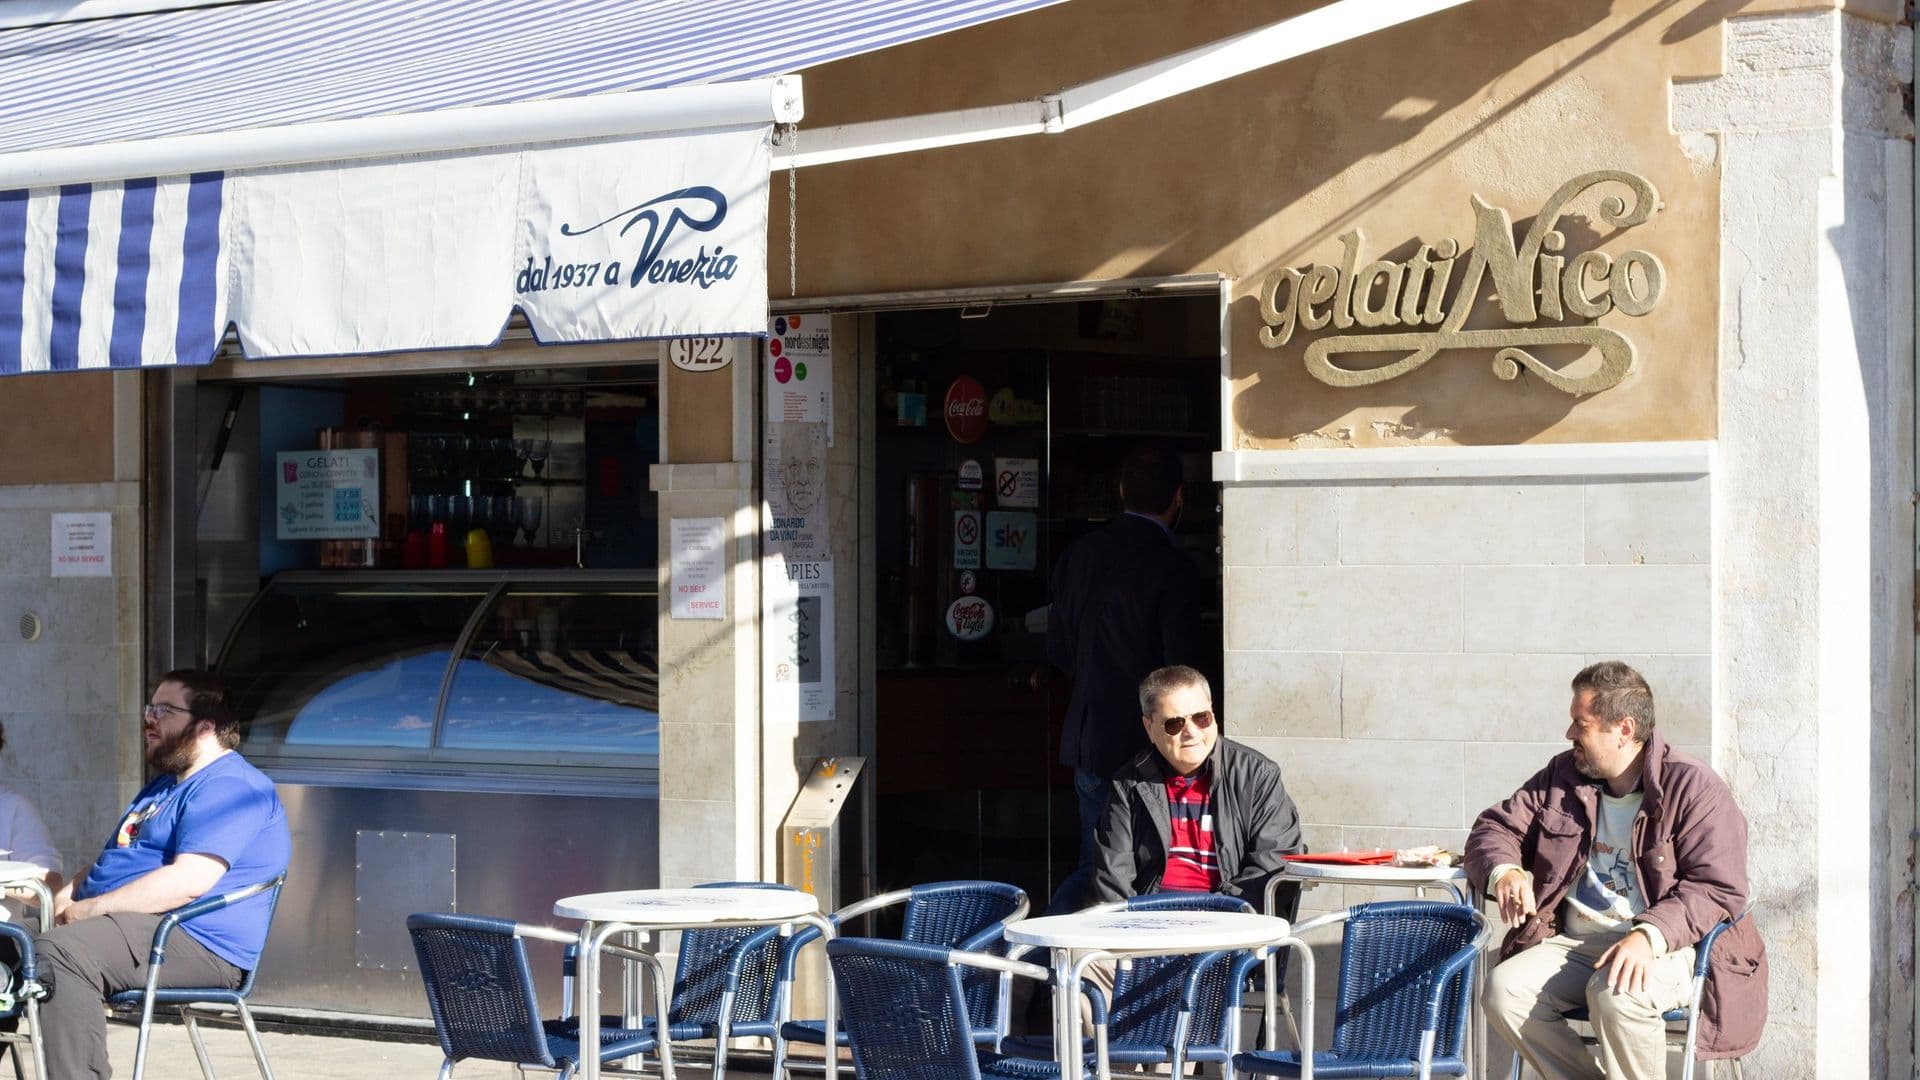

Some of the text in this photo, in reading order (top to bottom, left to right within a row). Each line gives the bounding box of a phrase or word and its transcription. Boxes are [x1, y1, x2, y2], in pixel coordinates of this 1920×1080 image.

[516, 186, 738, 294] dal 1937 a Venezia
[1259, 227, 1458, 348] gelati
[679, 338, 724, 365] 922
[307, 456, 349, 469] GELATI
[995, 524, 1028, 552] sky
[679, 585, 706, 593] NO SELF
[690, 601, 720, 609] SERVICE
